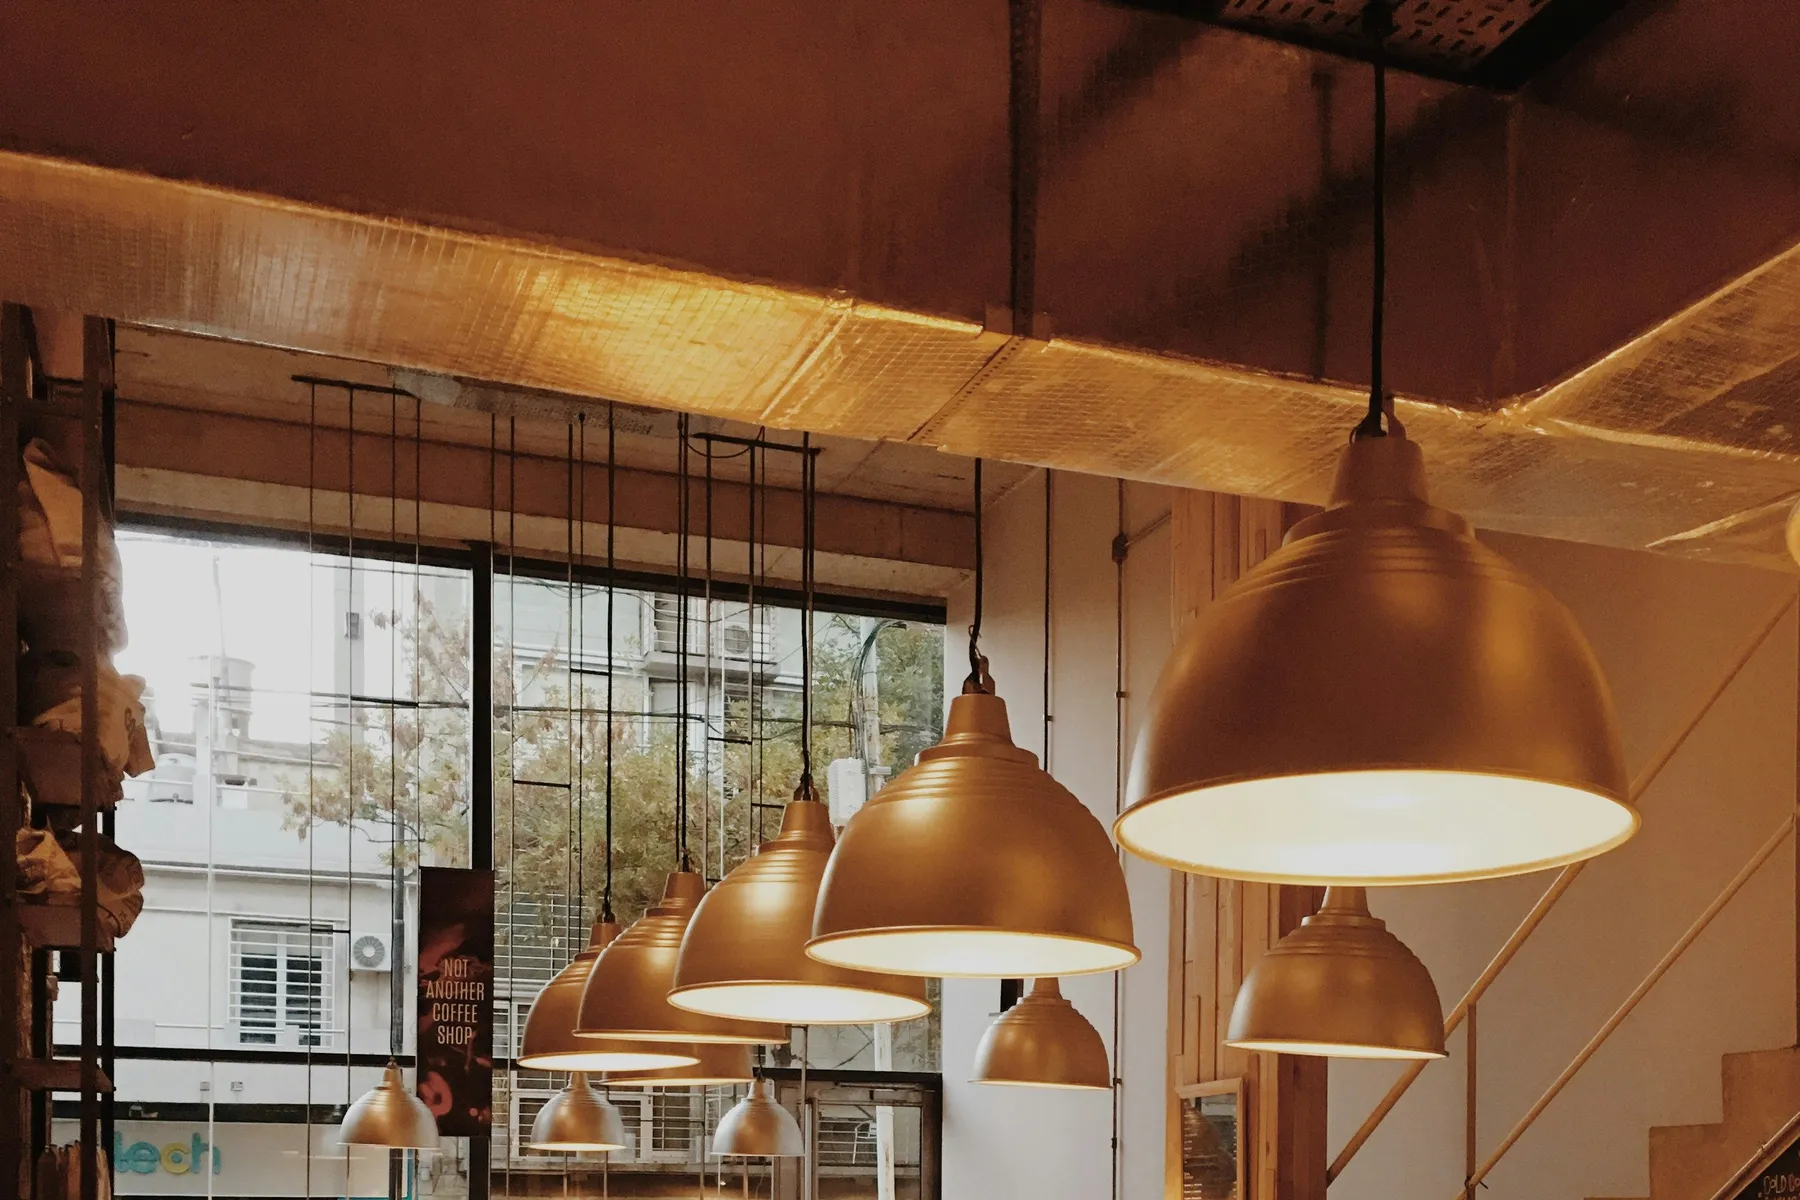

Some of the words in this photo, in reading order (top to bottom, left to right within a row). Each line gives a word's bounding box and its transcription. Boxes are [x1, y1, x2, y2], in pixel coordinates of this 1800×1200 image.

[444, 958, 469, 978] NOT
[425, 980, 485, 1001] ANOTHER
[432, 1002, 478, 1023] COFFEE
[437, 1025, 473, 1045] SHOP
